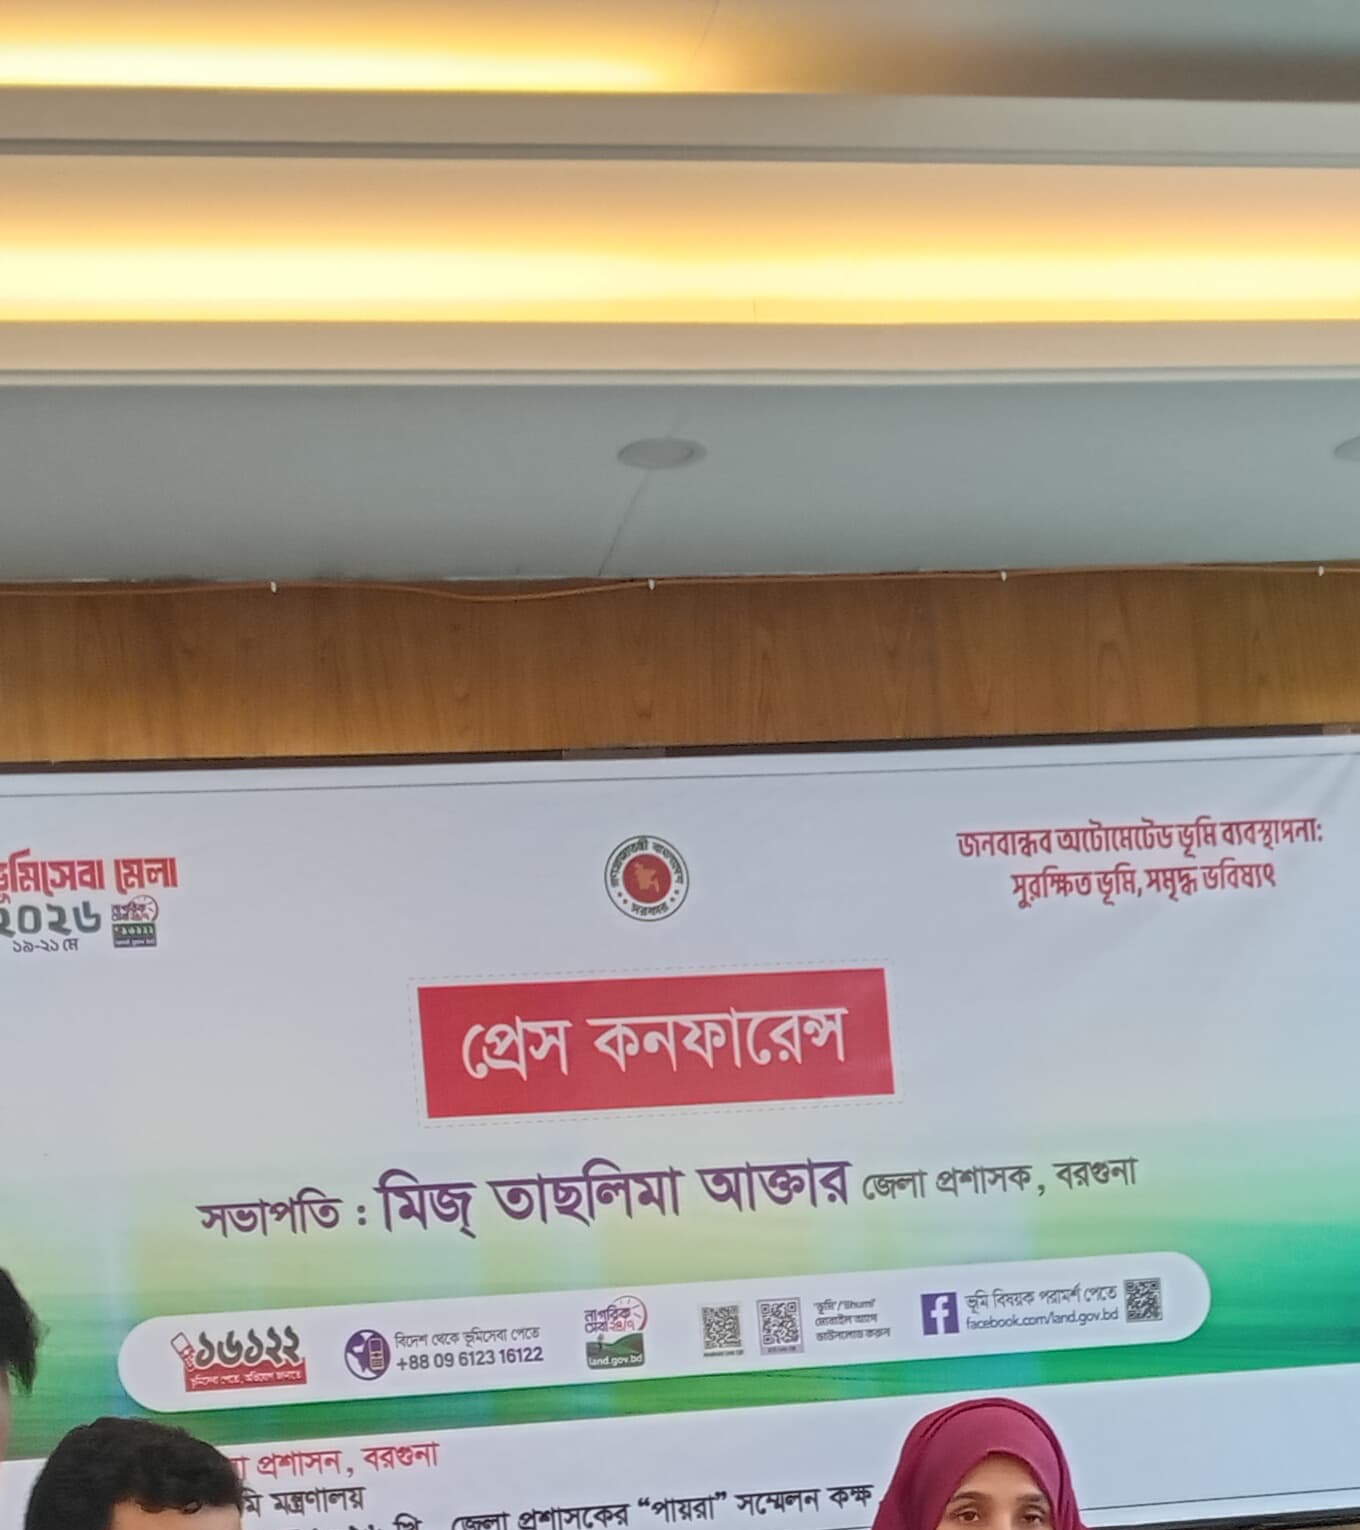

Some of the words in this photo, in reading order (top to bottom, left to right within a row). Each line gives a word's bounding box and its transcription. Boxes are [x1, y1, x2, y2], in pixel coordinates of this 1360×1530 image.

[956, 829, 1053, 858] জনবান্ধব
[1055, 818, 1173, 853] অটোমেটেড
[1177, 815, 1218, 858] ভূমি
[113, 857, 178, 895] মেলা
[1010, 865, 1093, 909] সুরক্ষিত
[1095, 862, 1143, 905] ভূমি,
[1202, 857, 1277, 891] ভবিষ্যৎ
[12, 939, 60, 953] ১৯-২১
[62, 937, 80, 951] মে
[461, 1015, 574, 1081] প্রেস
[585, 1006, 849, 1073] কনফারেন্স
[195, 1186, 343, 1238] সভাপতি
[486, 1157, 685, 1228] তাছলিমা
[695, 1157, 853, 1213] আক্তার
[862, 1168, 928, 1202] জেলা
[1052, 1155, 1139, 1191] বরগুনা
[964, 1289, 990, 1314] ভূমি
[966, 1308, 1119, 1331] facebook.com/land.gov.bd
[193, 1324, 301, 1368] ১৬১২২
[394, 1331, 428, 1348] বিদেশ
[510, 1327, 541, 1341] পেতে
[396, 1354, 430, 1371] +88
[434, 1352, 455, 1368] 09
[458, 1349, 496, 1367] 6123
[499, 1346, 544, 1365] 16122
[589, 1353, 643, 1367] land.gov.bd
[360, 1441, 440, 1472] বরগুনা
[269, 1486, 367, 1516] মন্ত্রণালয়
[734, 1488, 821, 1517] সম্মেলন
[827, 1484, 875, 1508] কক্ষ
